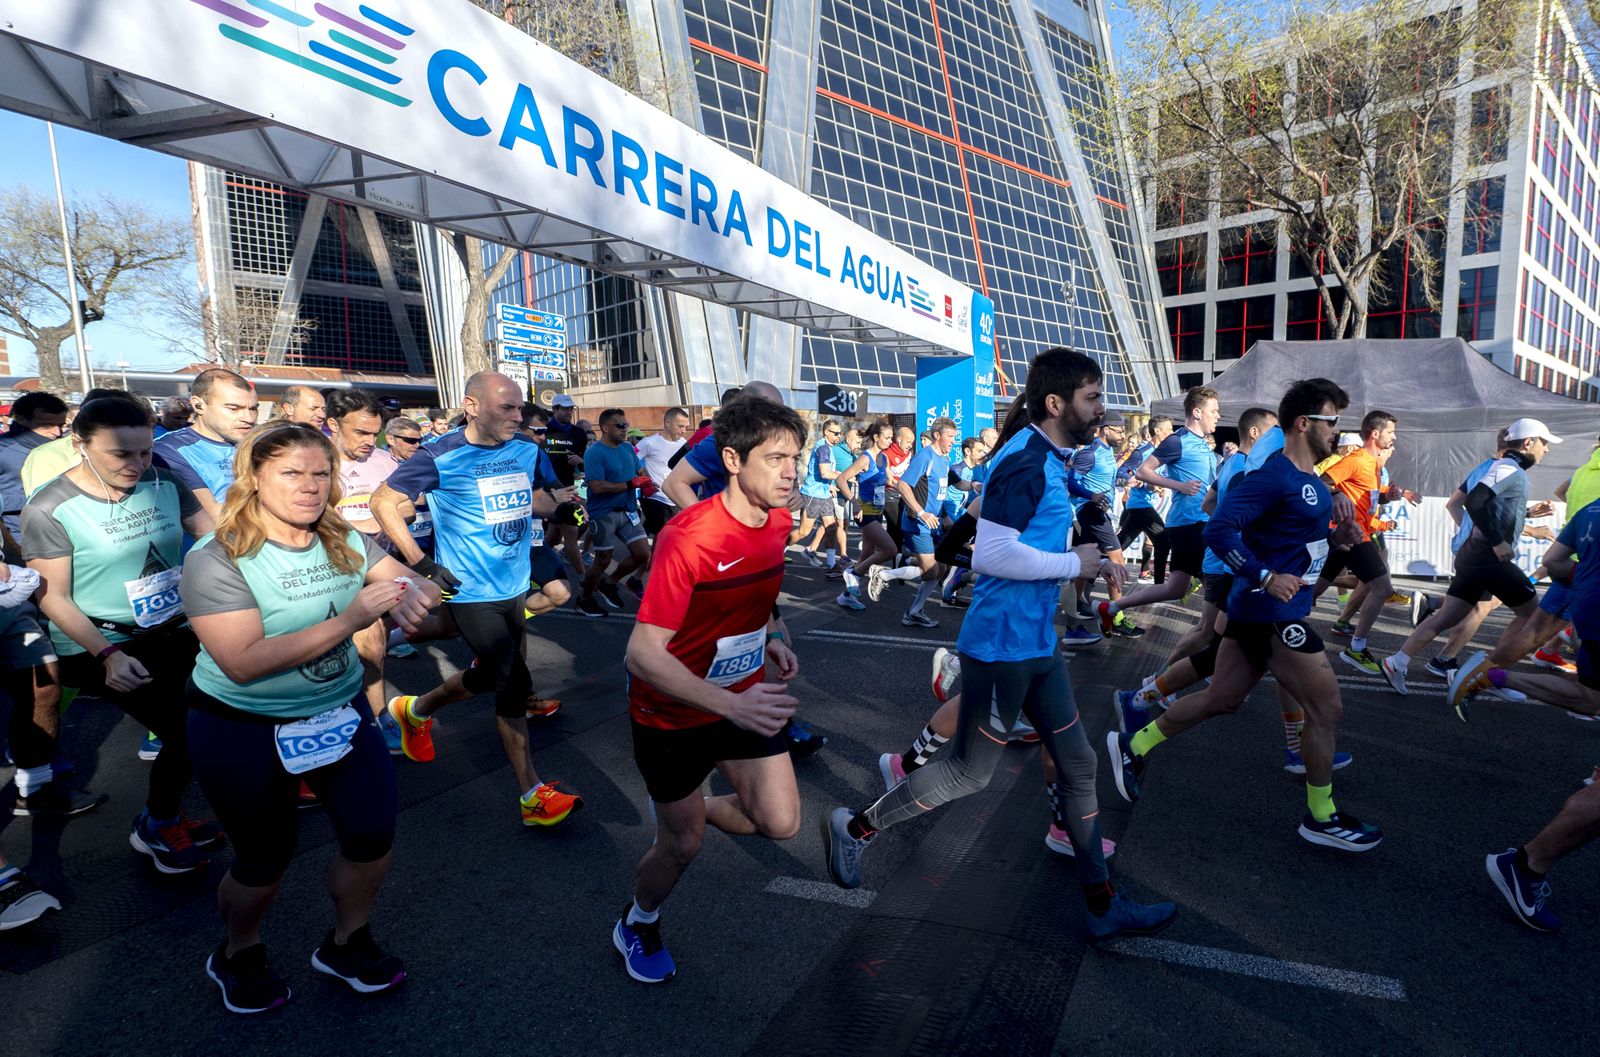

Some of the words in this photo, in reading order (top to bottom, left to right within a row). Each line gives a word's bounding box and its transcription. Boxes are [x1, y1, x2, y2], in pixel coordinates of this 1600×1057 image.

[427, 49, 753, 247] CARRERA
[767, 206, 831, 278] DEL
[840, 246, 906, 308] AGUA
[953, 399, 964, 423] Ojeda
[488, 491, 529, 511] 1842
[298, 562, 336, 577] CARRE
[282, 578, 307, 590] DEL
[310, 571, 340, 585] AGUA
[102, 622, 116, 630] edp
